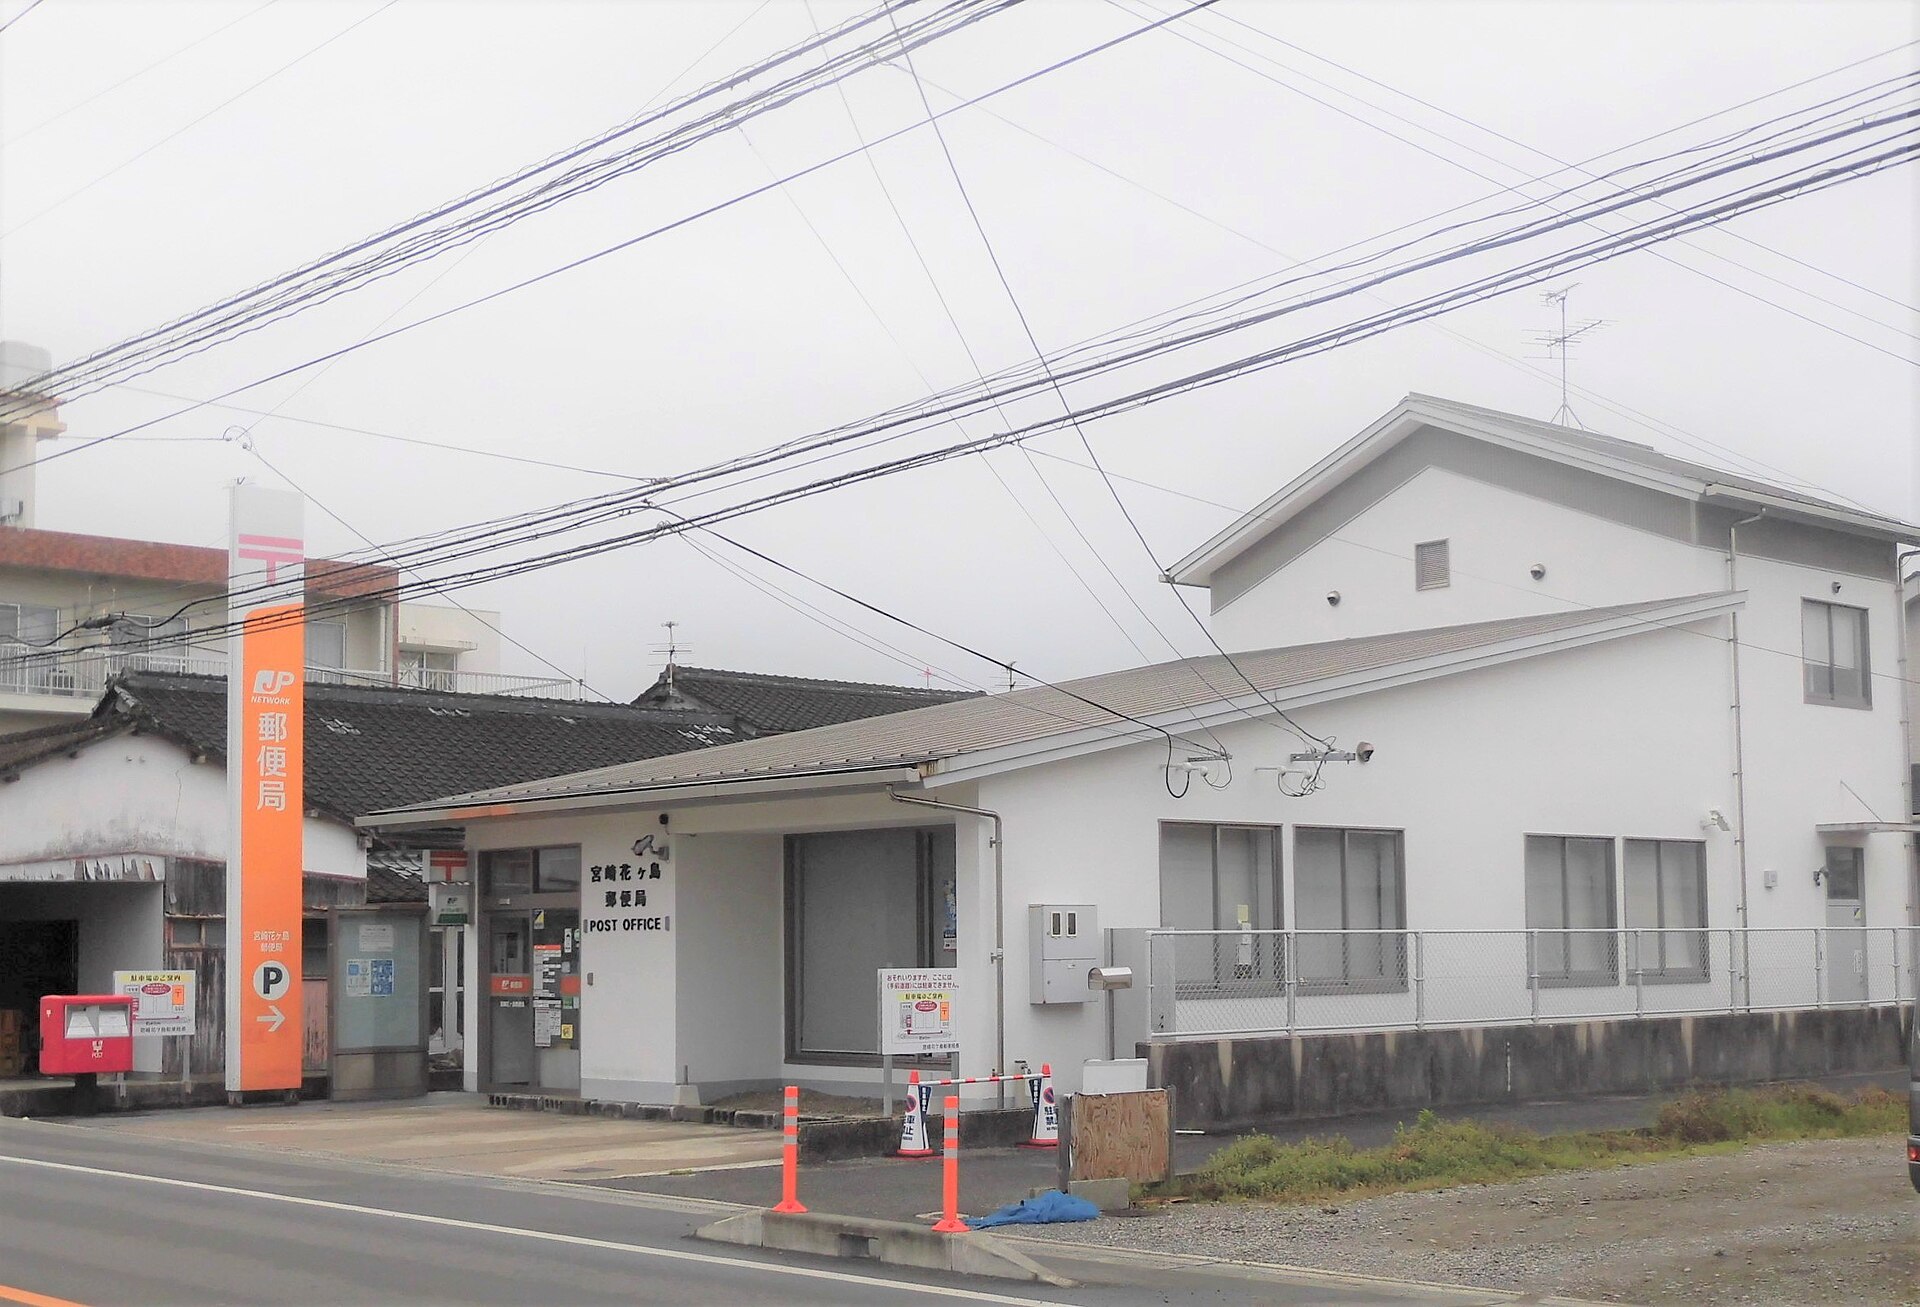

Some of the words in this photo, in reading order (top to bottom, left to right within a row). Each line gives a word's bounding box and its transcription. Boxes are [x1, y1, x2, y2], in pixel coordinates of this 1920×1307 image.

[251, 696, 291, 705] NETWORK
[257, 712, 288, 811] 郵便局
[605, 889, 647, 908] 郵便局
[589, 919, 618, 932] POST
[622, 917, 661, 931] OFFICE
[263, 966, 283, 994] P
